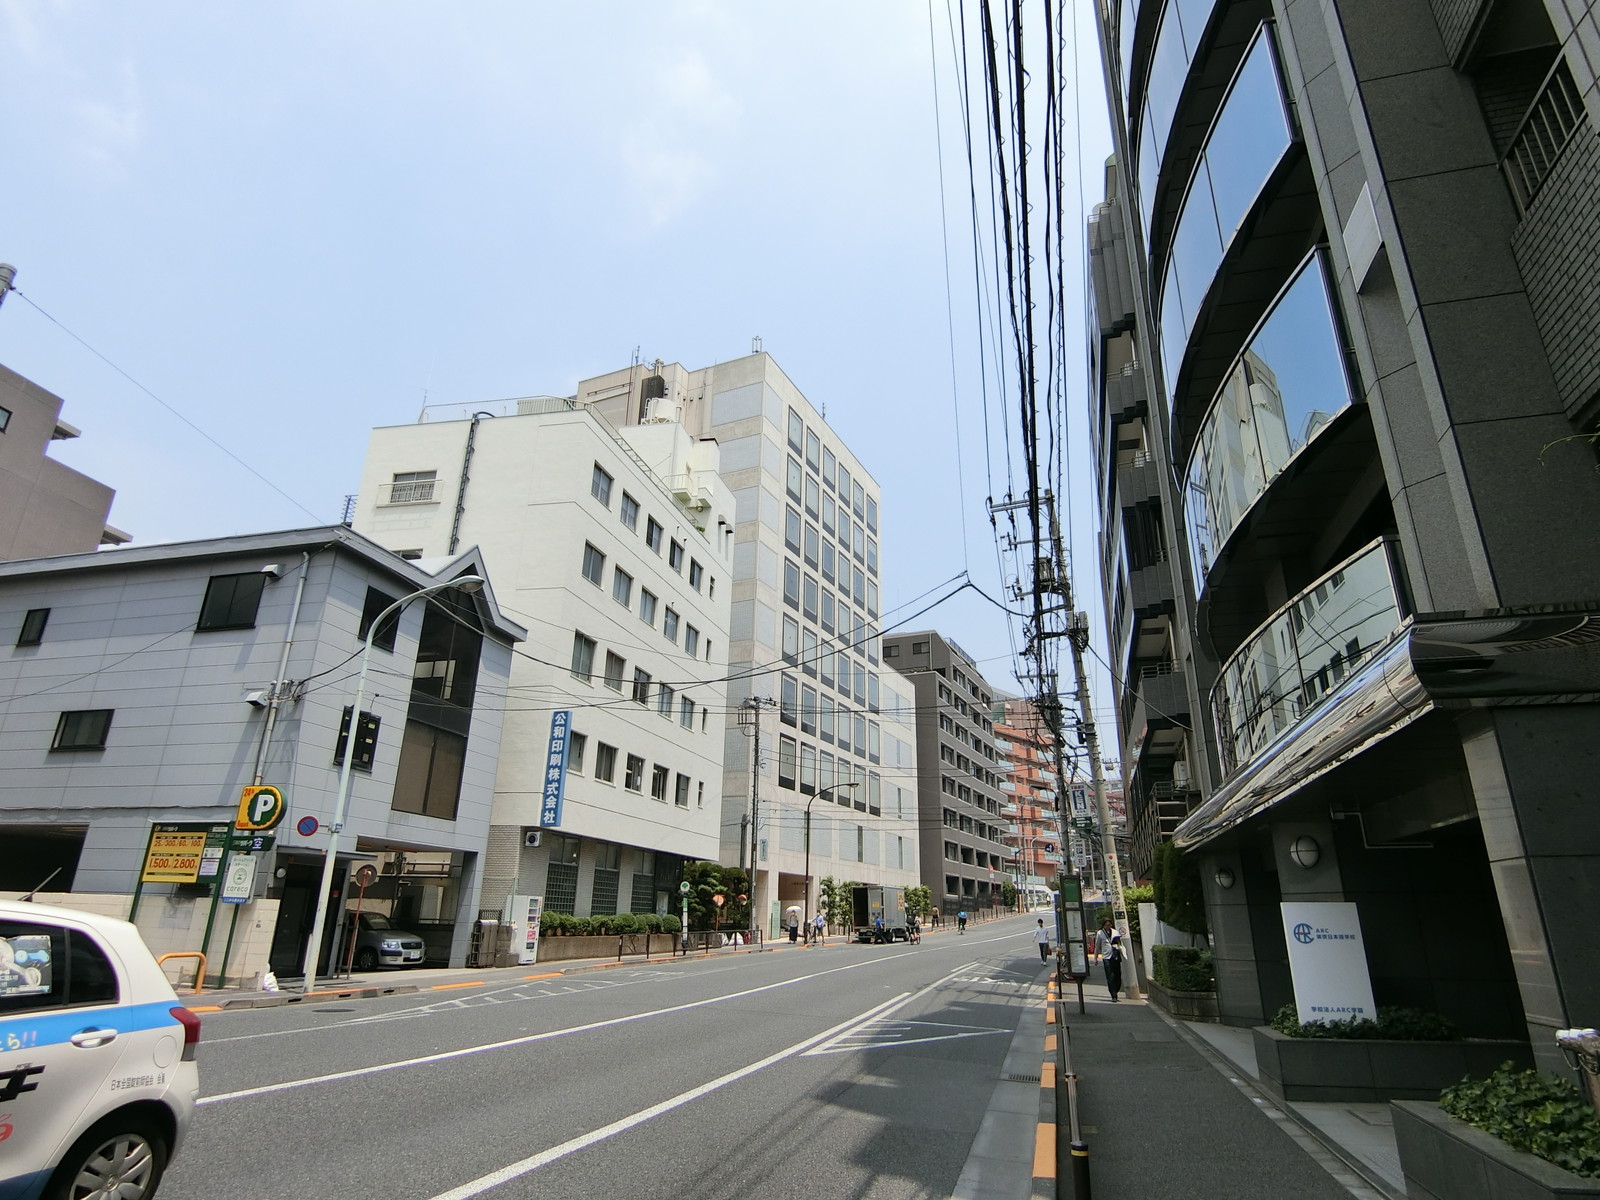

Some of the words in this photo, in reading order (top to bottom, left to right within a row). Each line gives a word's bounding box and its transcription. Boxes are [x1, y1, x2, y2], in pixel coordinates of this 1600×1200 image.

[543, 712, 567, 824] 公和印刷株式会社
[253, 794, 275, 822] P
